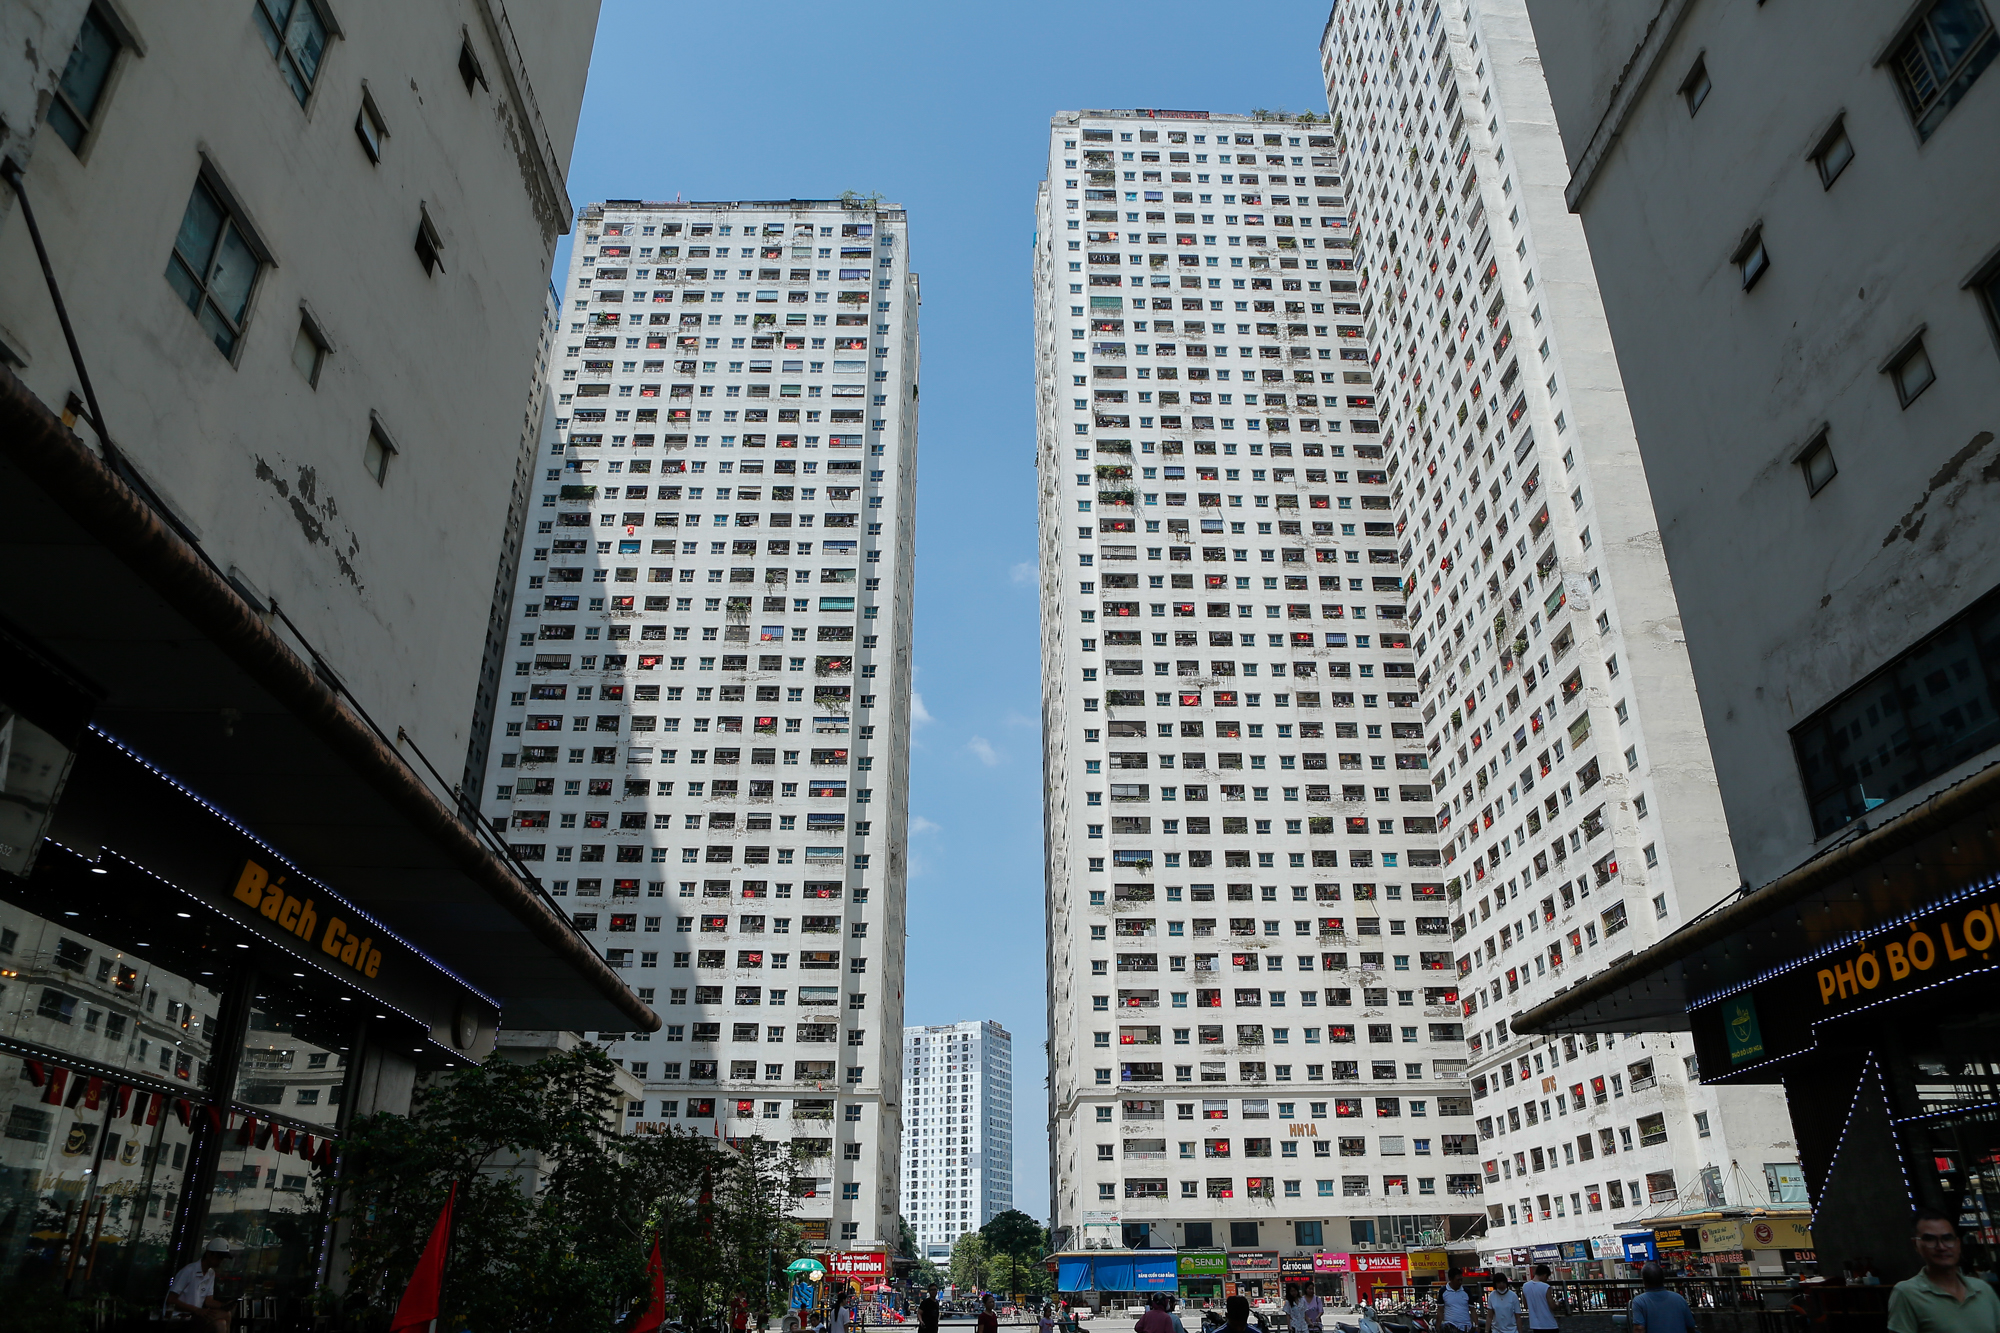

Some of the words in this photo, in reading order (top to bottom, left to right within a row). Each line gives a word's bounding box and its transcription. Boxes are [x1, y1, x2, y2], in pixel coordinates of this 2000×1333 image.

[233, 859, 318, 942] Bách
[322, 917, 382, 978] Cafe
[1817, 941, 1880, 1005] PHỞ
[1885, 922, 1935, 981] BÒ
[1289, 1123, 1318, 1137] HH1A
[1668, 1229, 1682, 1237] STORE
[1195, 1258, 1224, 1266] SENLIN
[1292, 1262, 1301, 1270] TÓC
[1368, 1256, 1401, 1266] MIXUE
[830, 1261, 852, 1274] TUỆ
[853, 1262, 882, 1271] MINH
